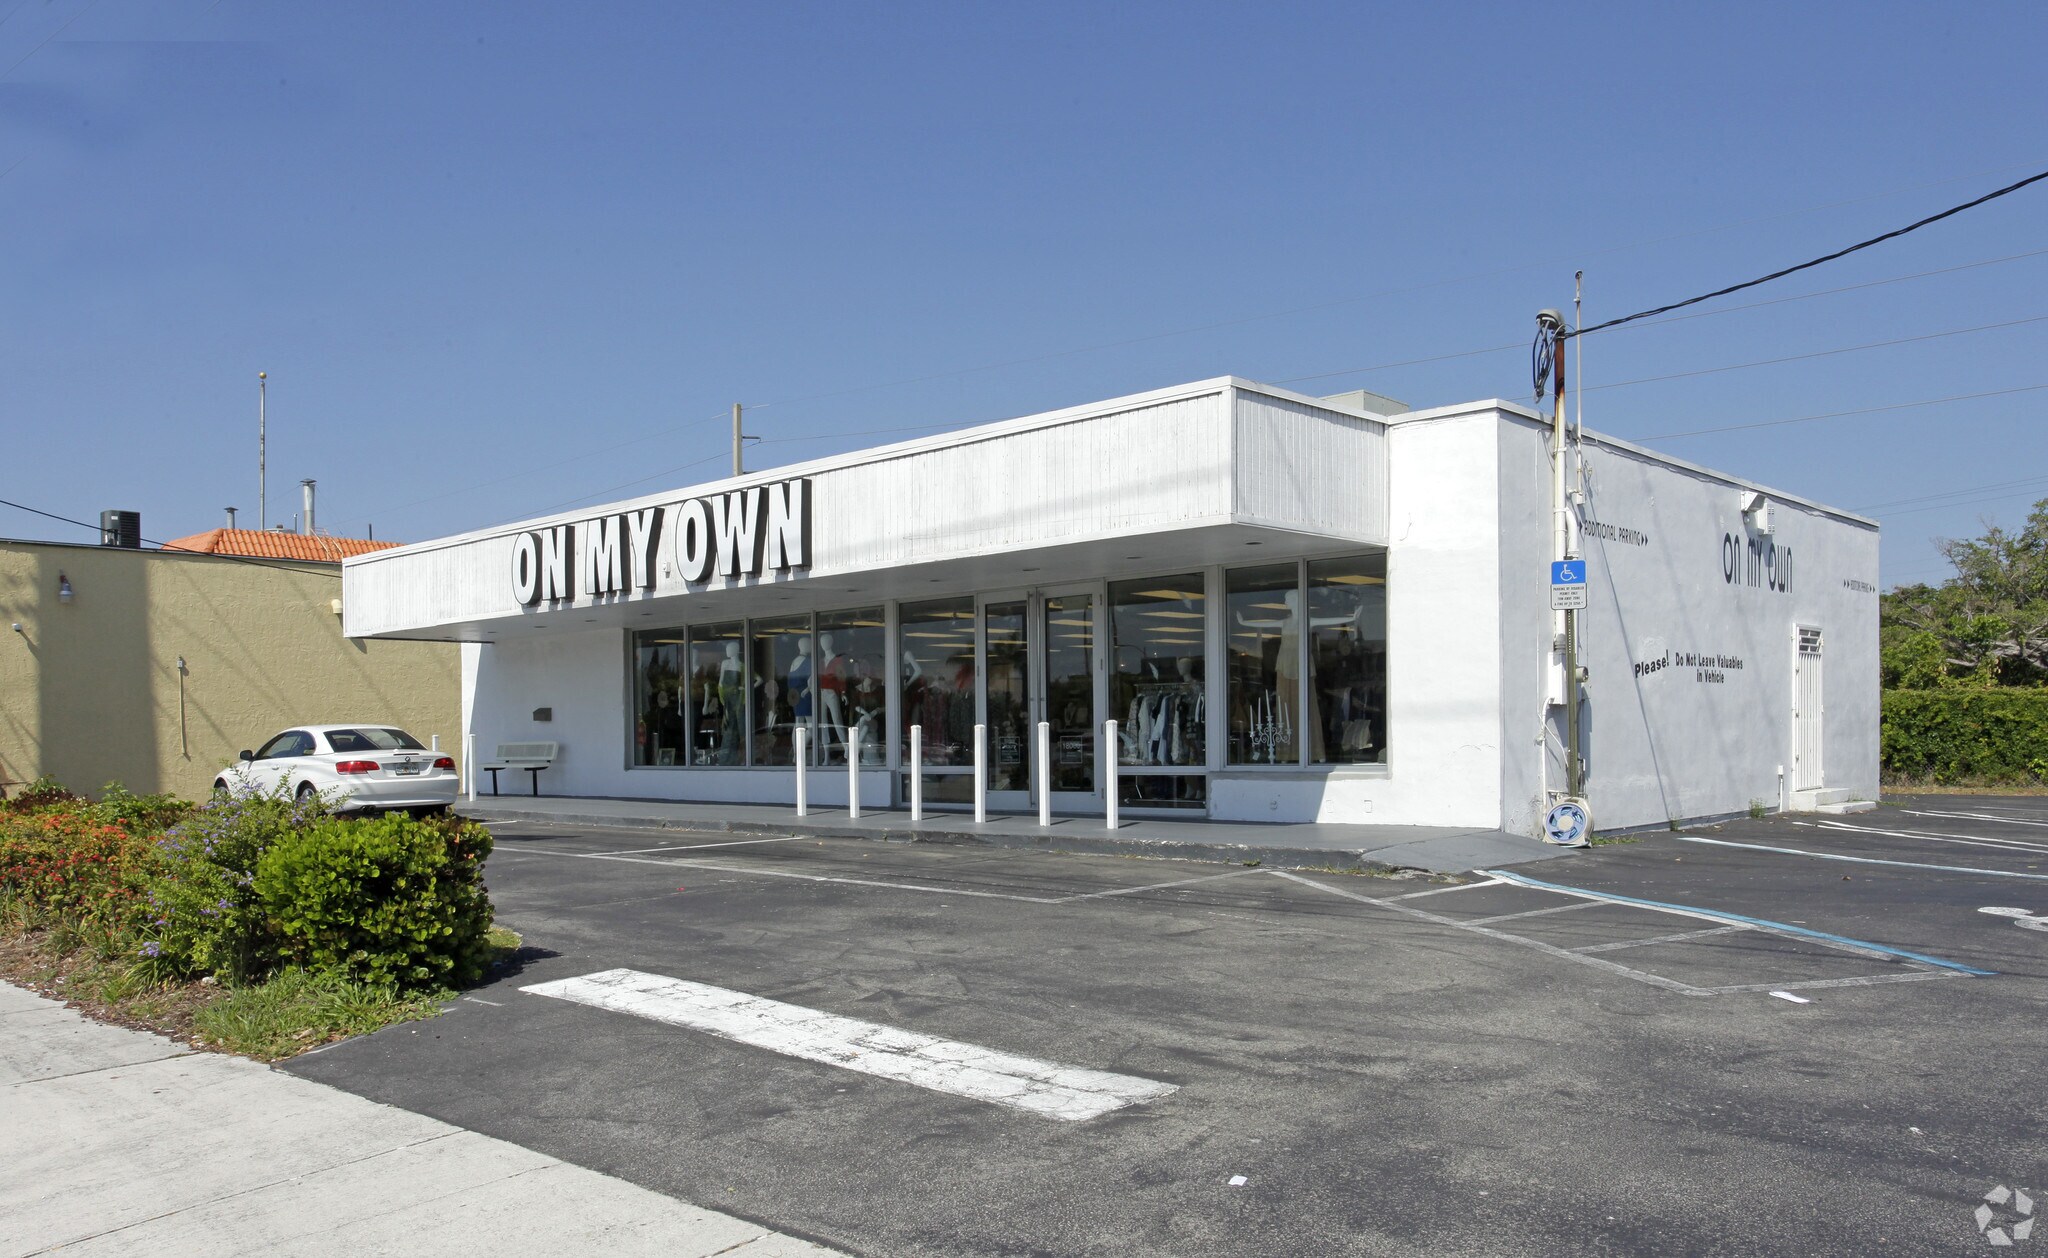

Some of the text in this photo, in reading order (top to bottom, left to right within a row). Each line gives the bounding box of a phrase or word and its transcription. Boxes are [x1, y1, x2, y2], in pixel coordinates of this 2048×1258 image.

[512, 478, 812, 605] ON MY OWN
[1584, 519, 1641, 547] ADDITIONAL PARKING
[1634, 649, 1743, 679] Please! Do Not Leave Valuables
[1697, 669, 1724, 683] in Vehicle
